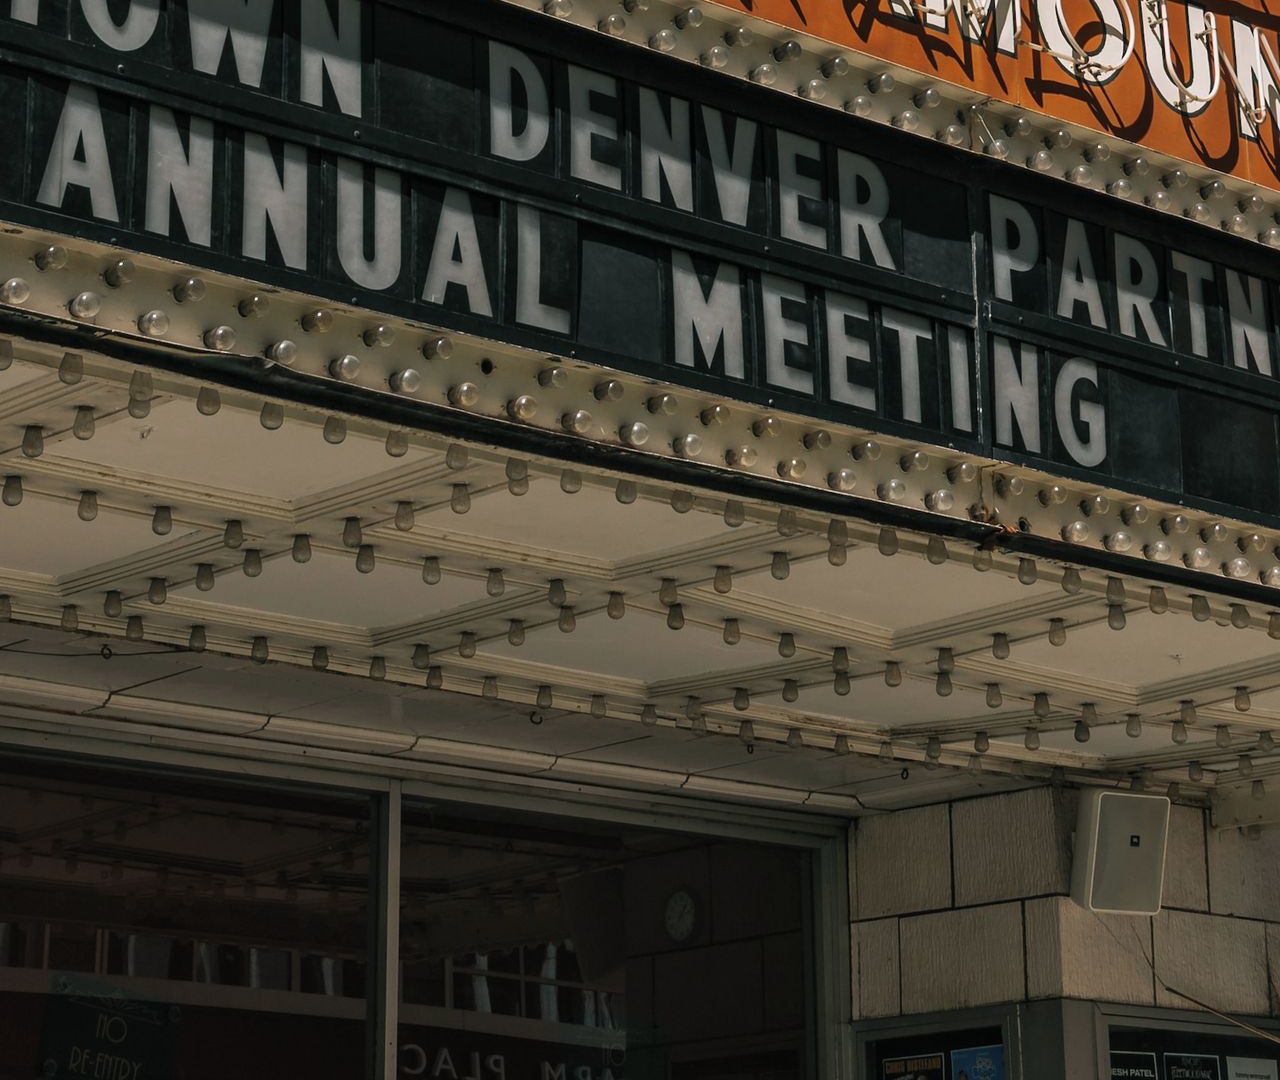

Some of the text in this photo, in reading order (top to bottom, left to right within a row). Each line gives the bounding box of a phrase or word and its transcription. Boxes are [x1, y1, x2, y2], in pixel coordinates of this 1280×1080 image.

[488, 40, 896, 270] DENVER
[36, 78, 572, 335] ANNUAL
[670, 249, 1107, 468] MEETING
[95, 1013, 128, 1044] NO
[69, 1045, 144, 1080] RE-ENTRY
[1129, 1068, 1155, 1078] PATEL
